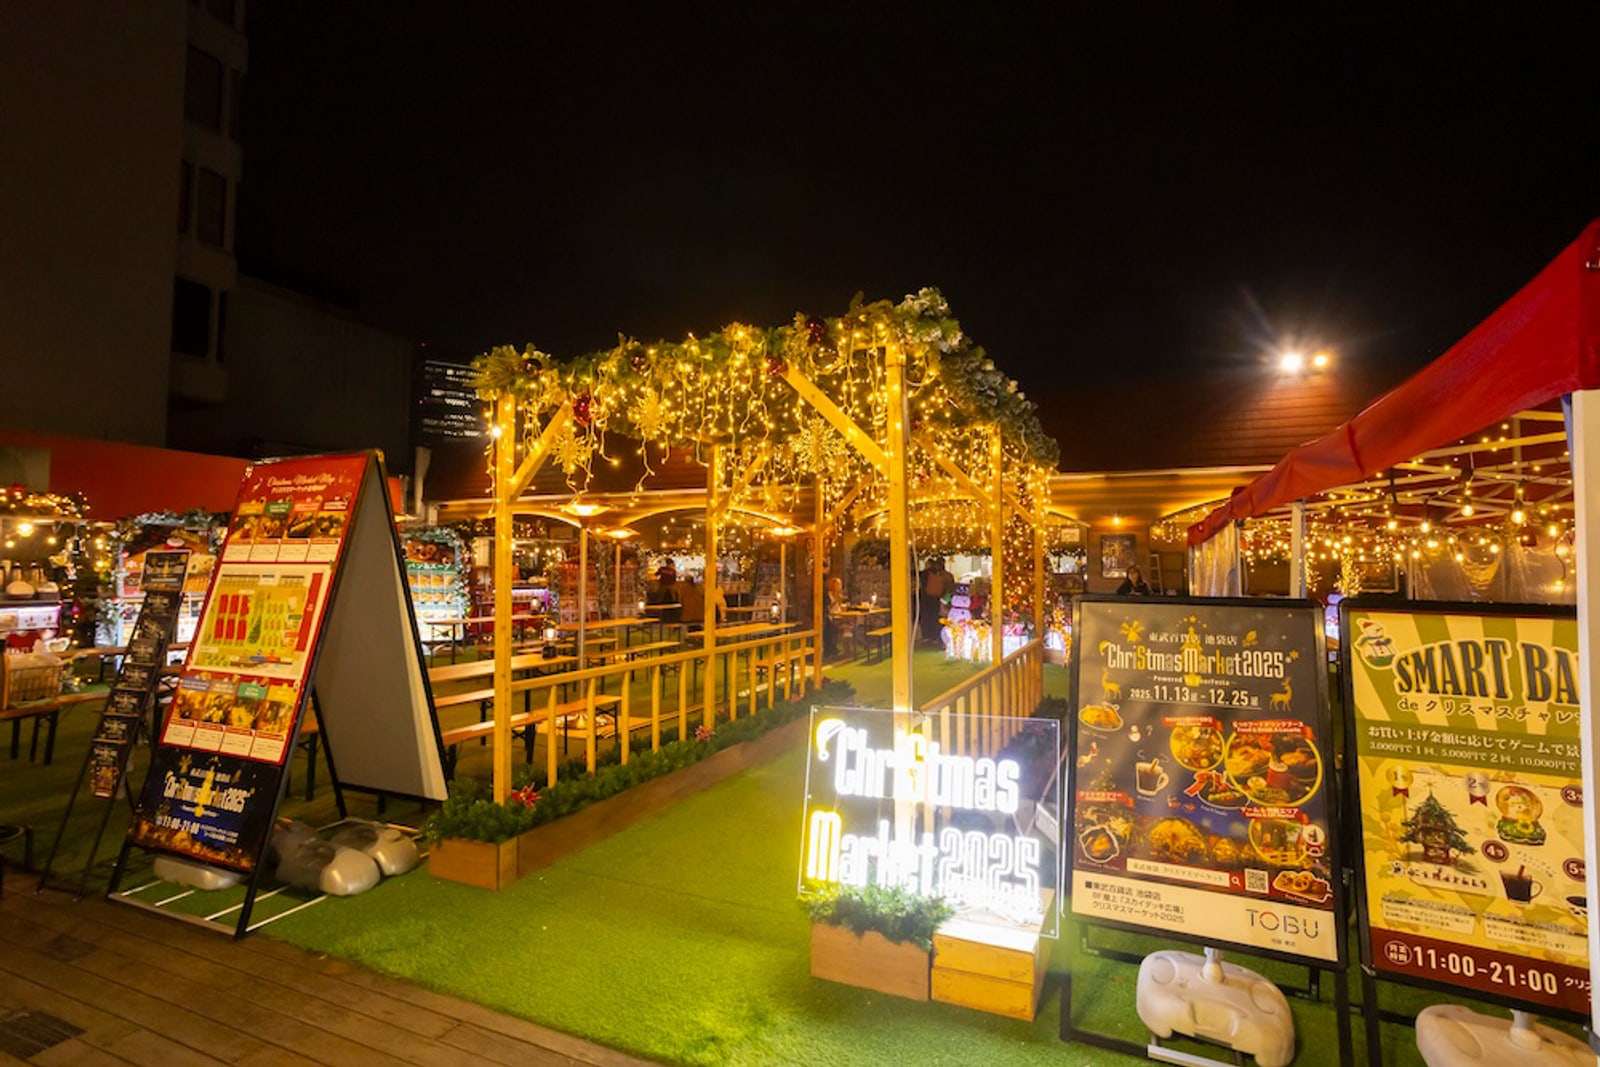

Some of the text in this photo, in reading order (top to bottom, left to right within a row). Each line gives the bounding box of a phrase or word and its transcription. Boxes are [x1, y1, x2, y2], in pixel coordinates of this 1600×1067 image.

[1396, 640, 1580, 705] SMART BA
[1400, 697, 1582, 726] de クリスマスチャレ
[1245, 908, 1319, 939] TOBU
[1413, 945, 1558, 995] 11:00-21:00
